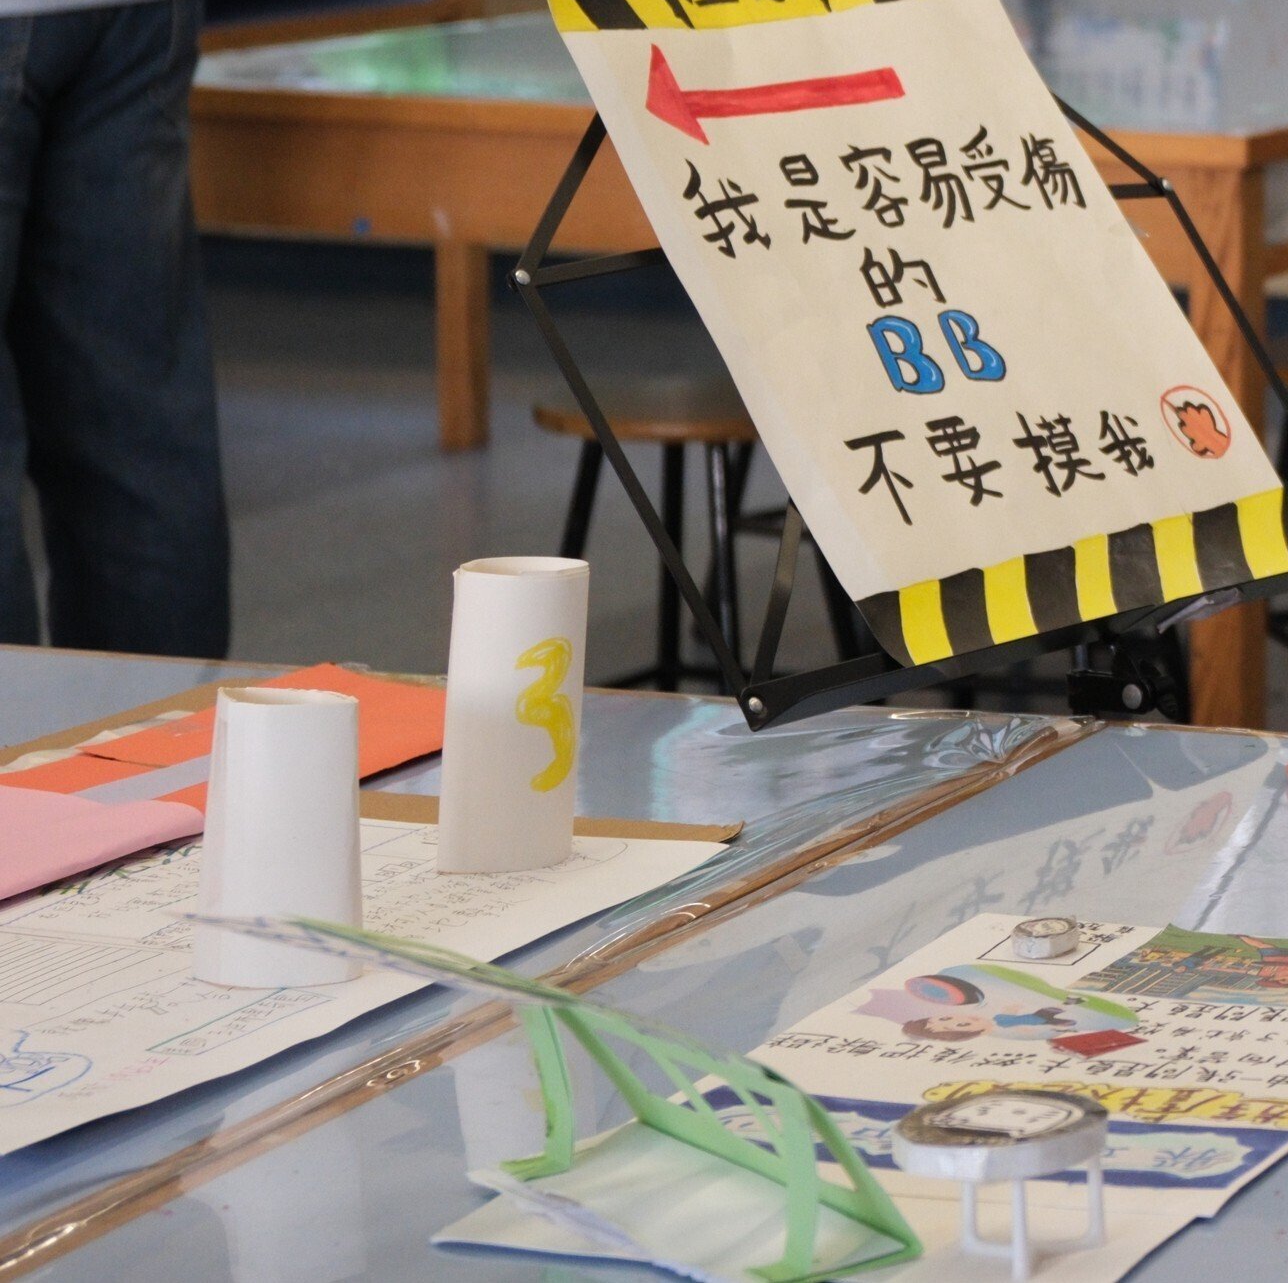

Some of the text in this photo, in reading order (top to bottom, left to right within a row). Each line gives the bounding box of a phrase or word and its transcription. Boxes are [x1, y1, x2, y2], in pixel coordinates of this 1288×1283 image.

[681, 123, 1088, 263] 我是容易受傷
[859, 244, 949, 309] 的
[866, 308, 1008, 396] BB
[843, 408, 1157, 526] 不要摸我
[513, 635, 576, 793] 3
